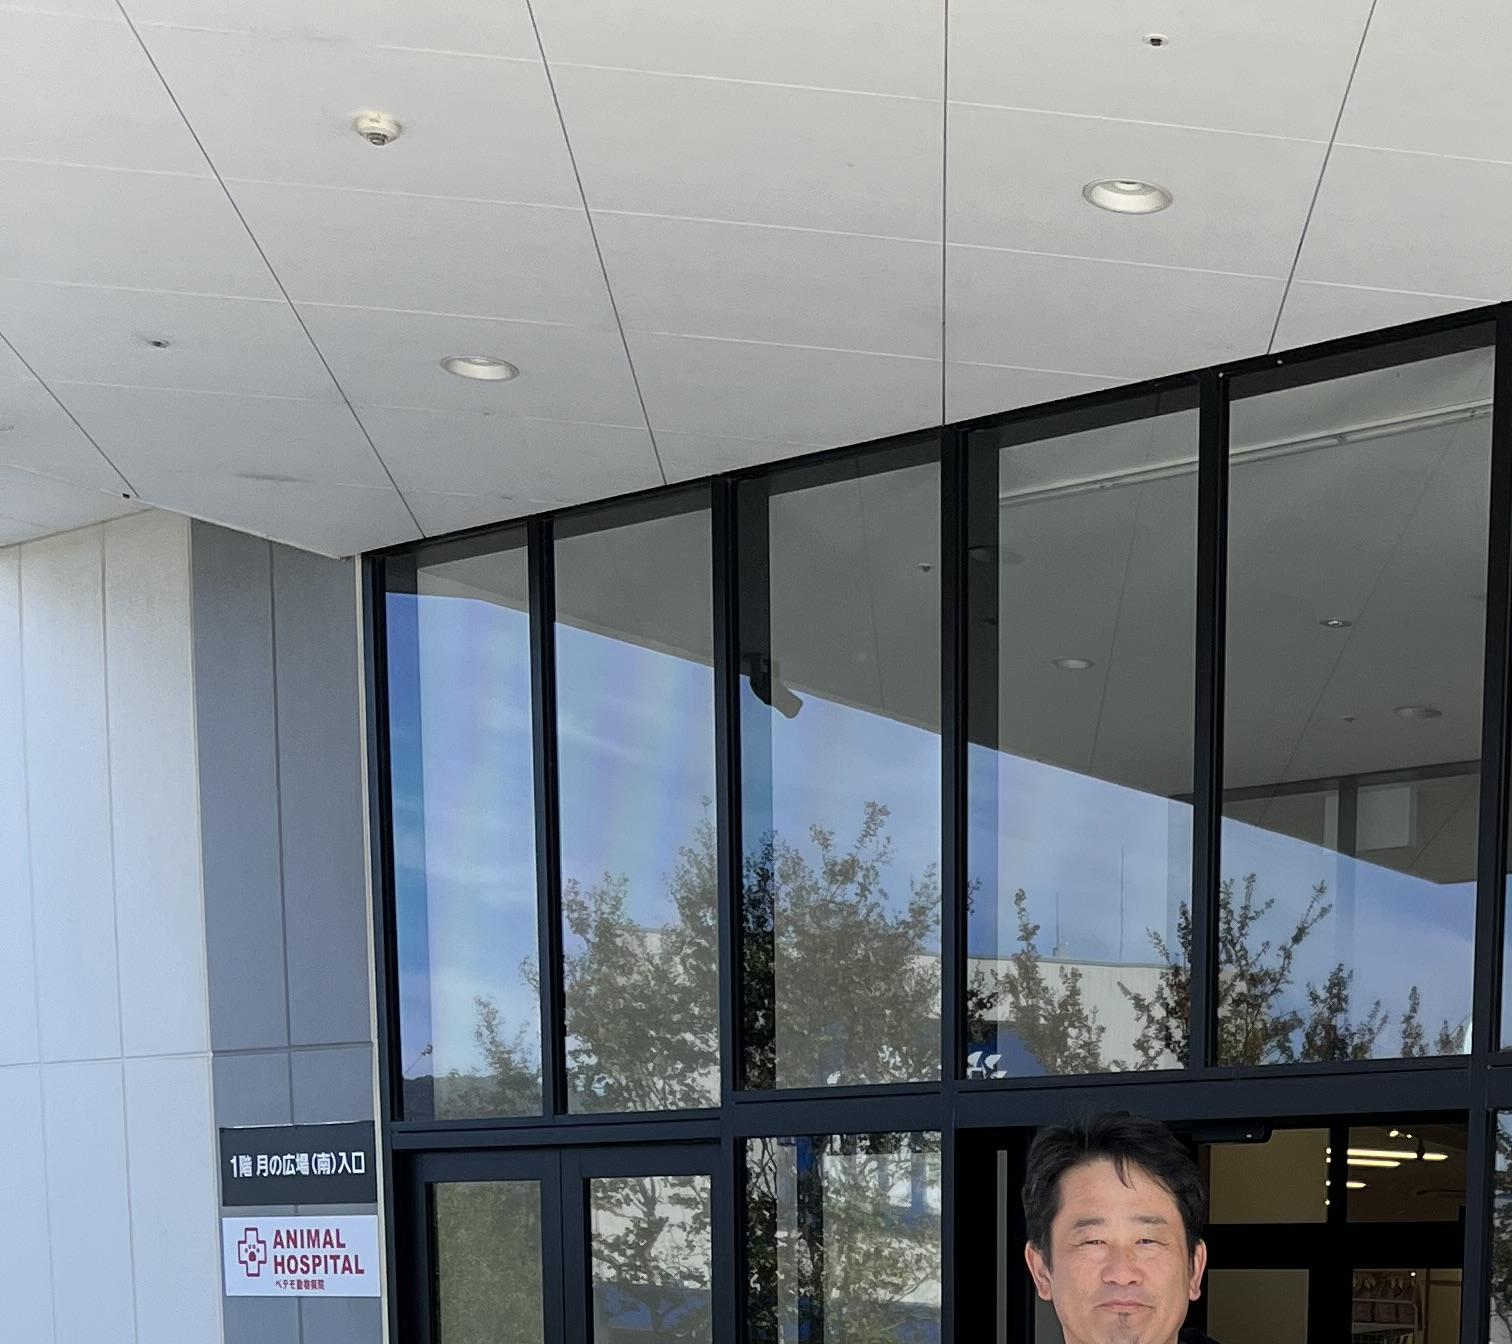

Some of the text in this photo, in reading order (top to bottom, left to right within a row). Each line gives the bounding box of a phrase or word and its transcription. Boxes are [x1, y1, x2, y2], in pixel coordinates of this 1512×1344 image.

[230, 1155, 253, 1178] 1階
[272, 1228, 346, 1249] ANIMAL
[273, 1254, 365, 1275] HOSPITAL
